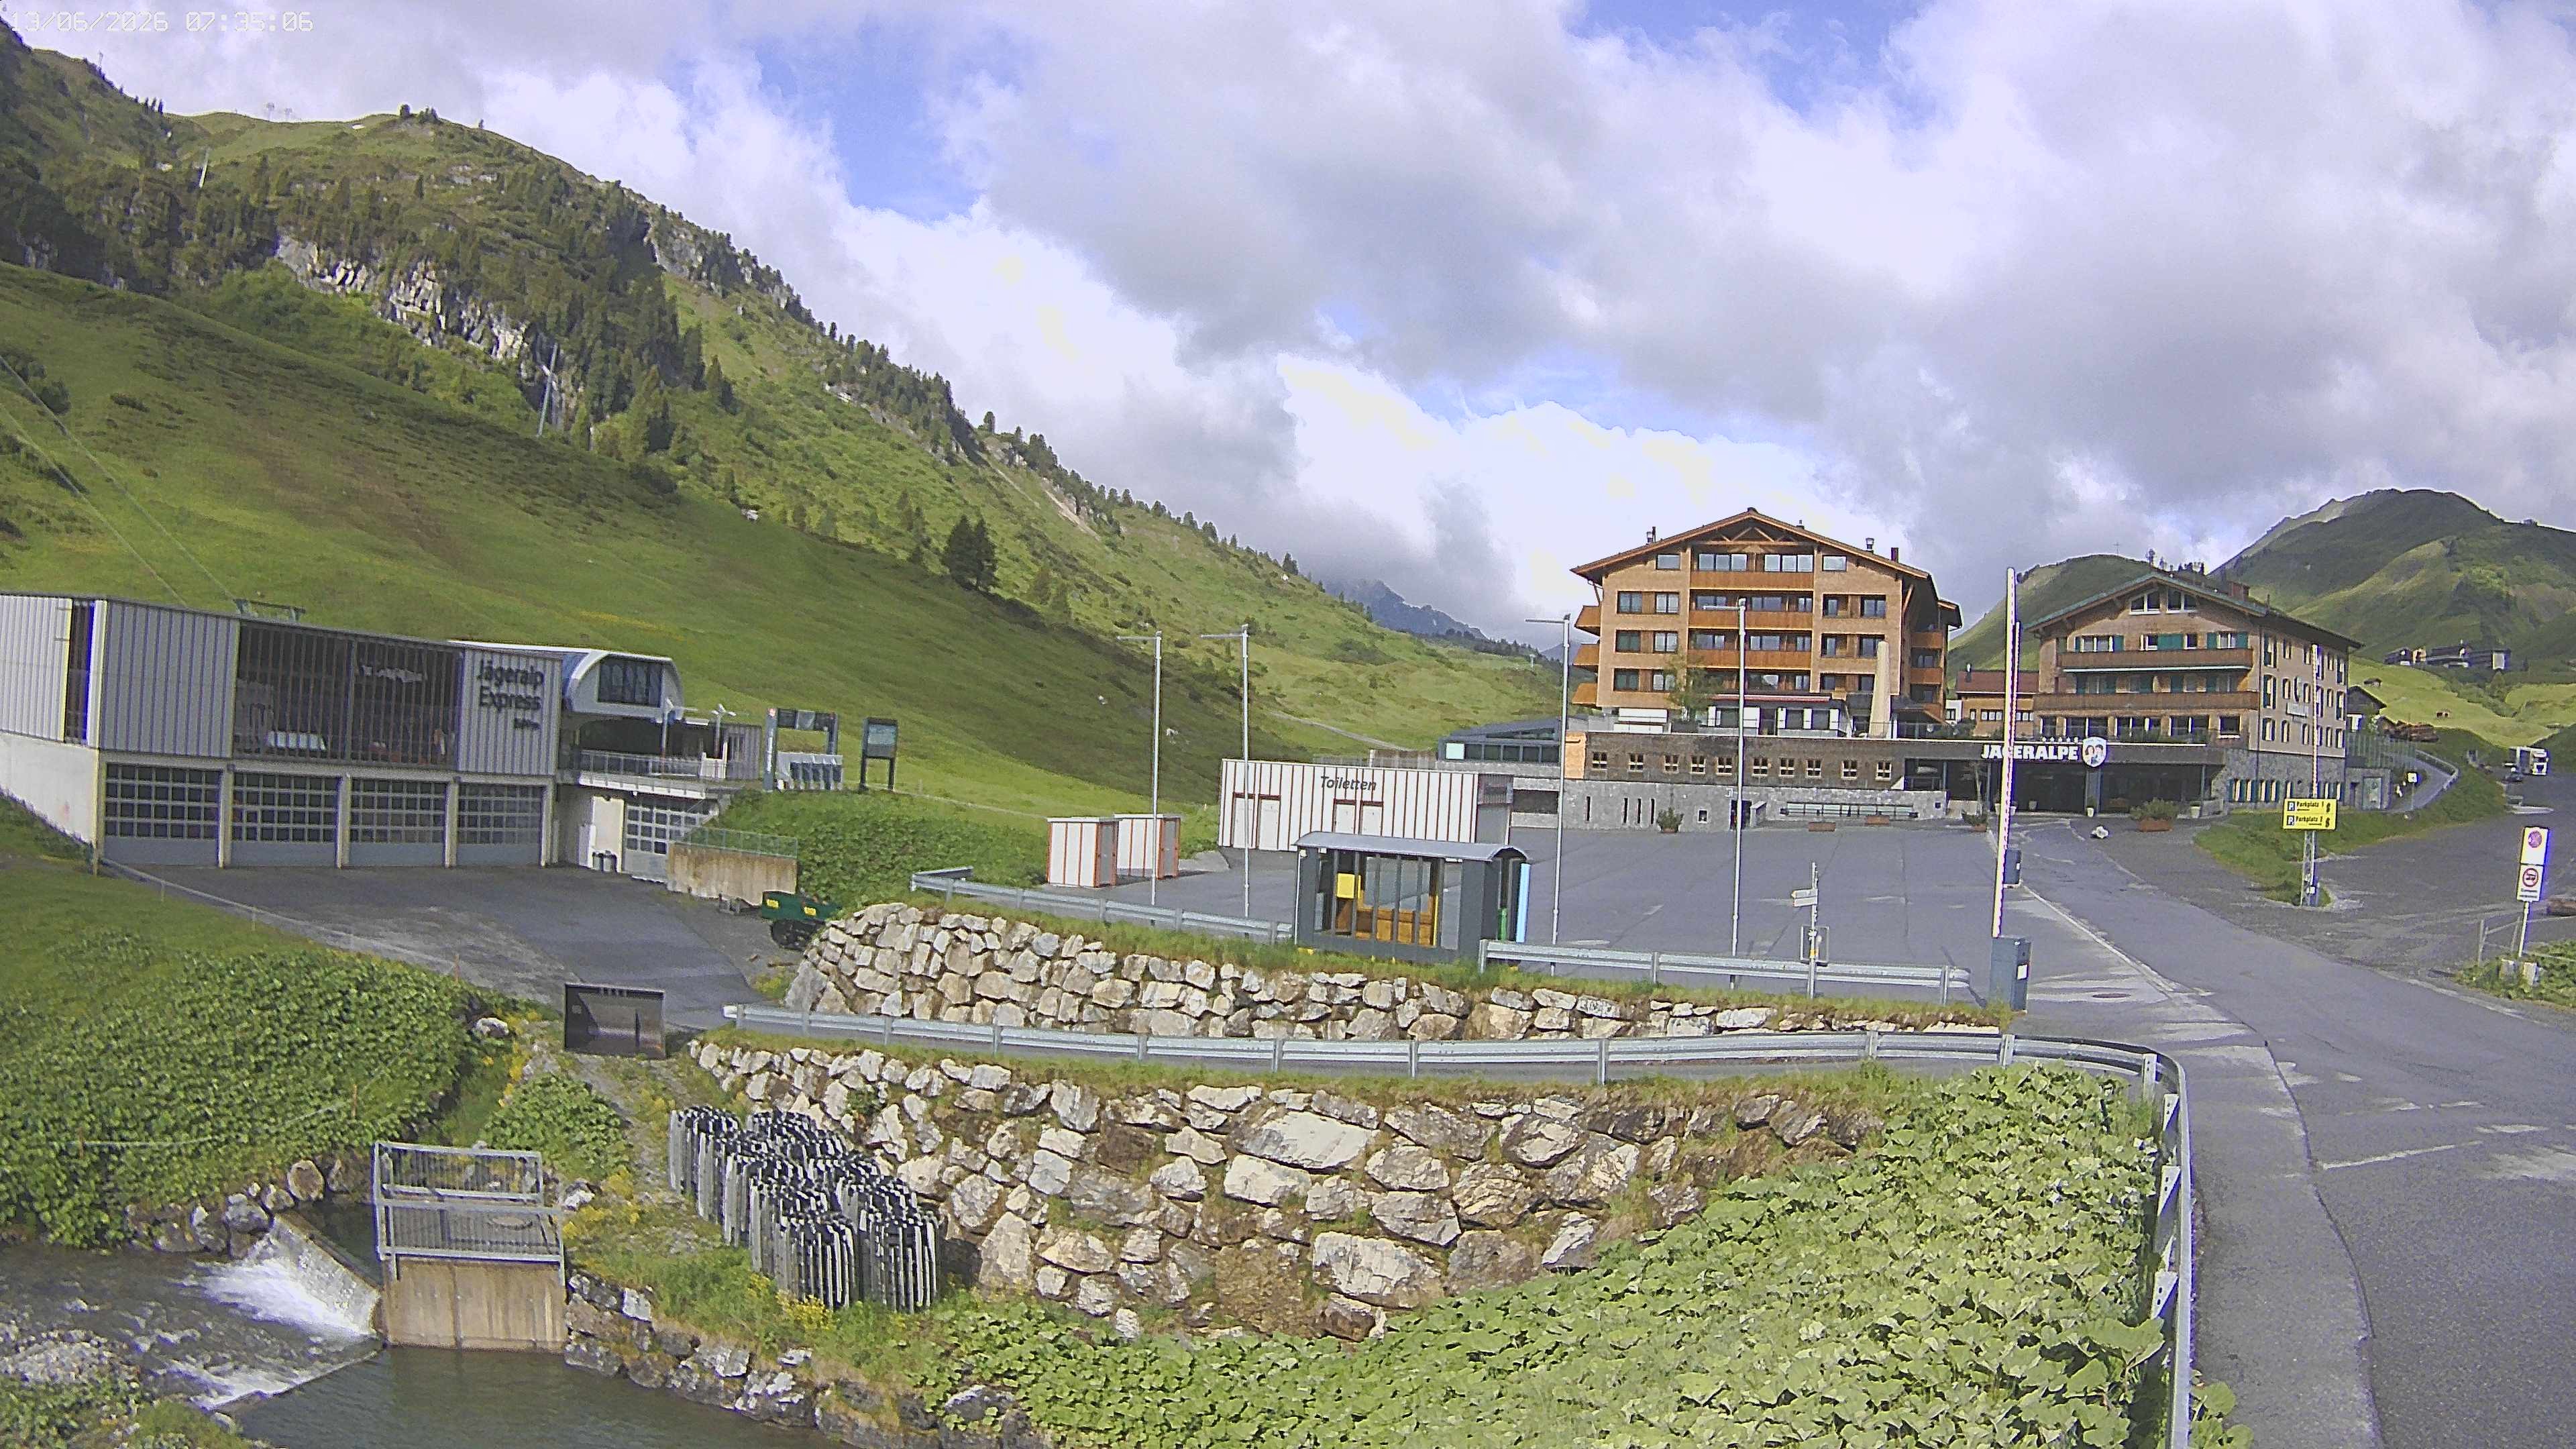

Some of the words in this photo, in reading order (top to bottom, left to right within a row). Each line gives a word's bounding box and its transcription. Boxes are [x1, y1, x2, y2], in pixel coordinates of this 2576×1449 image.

[477, 659, 545, 691] Jägeralp
[480, 686, 541, 714] Express
[1981, 744, 2078, 761] JAERALPE
[1320, 775, 1377, 791] Toiletten
